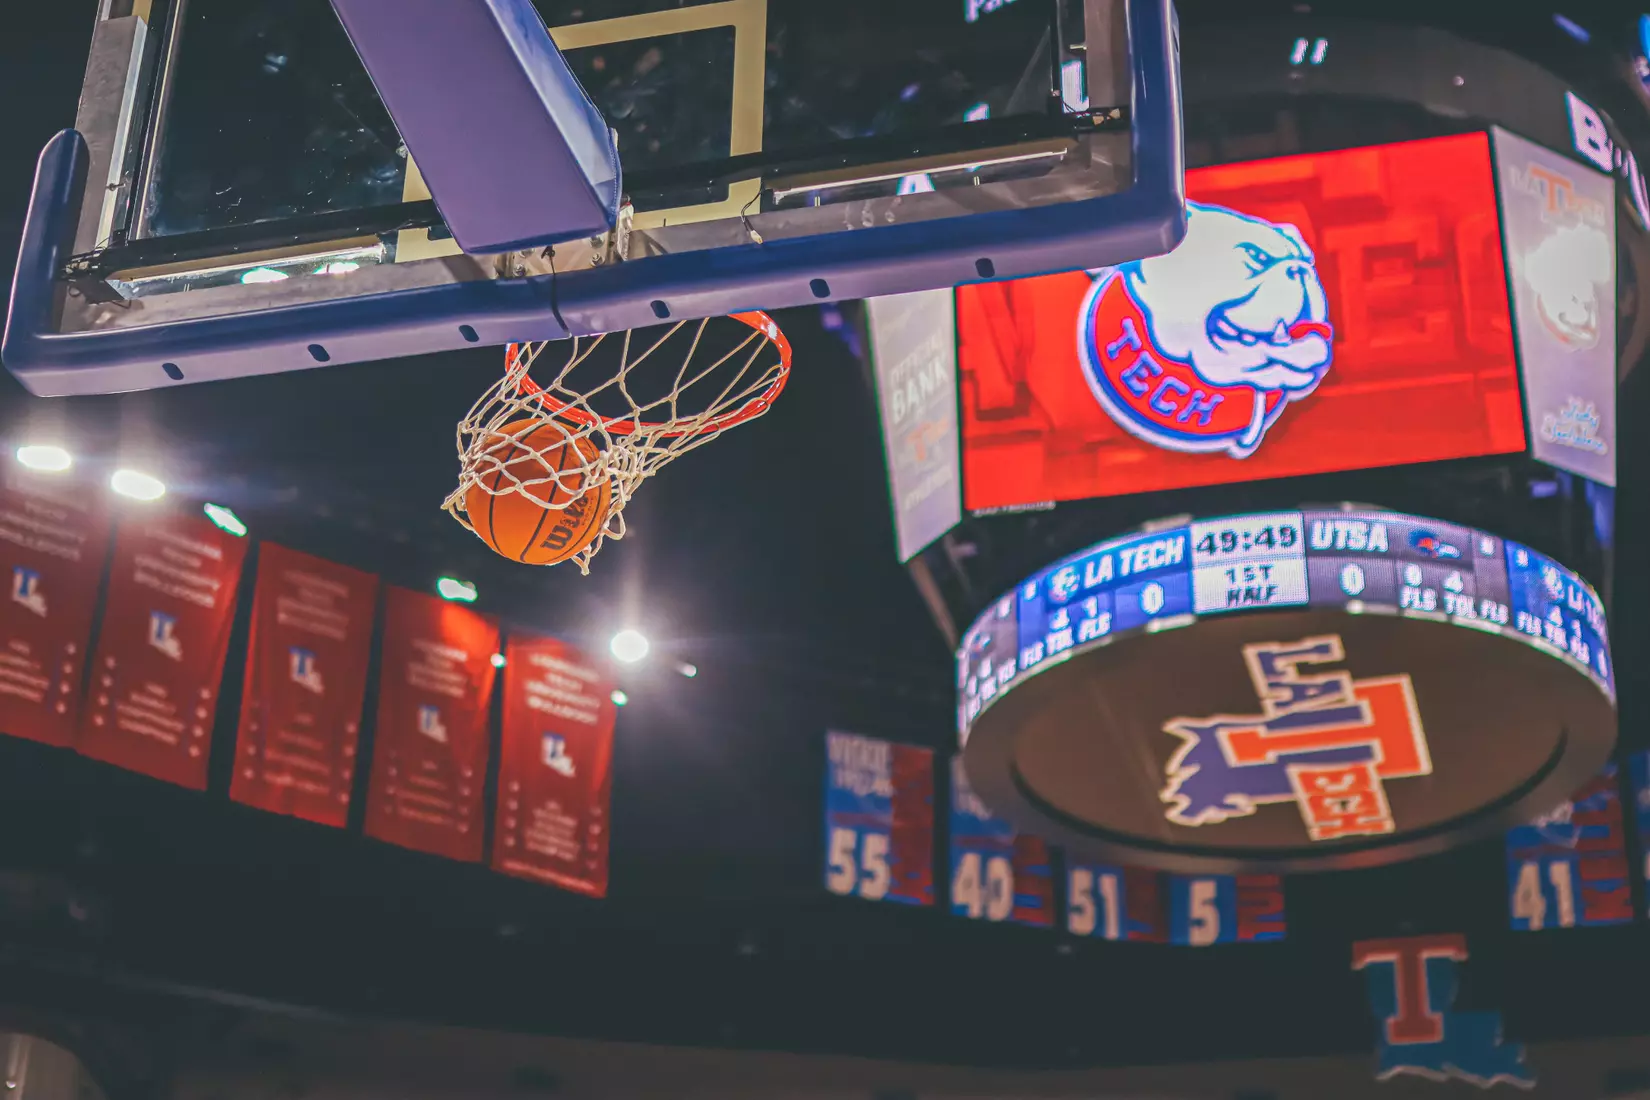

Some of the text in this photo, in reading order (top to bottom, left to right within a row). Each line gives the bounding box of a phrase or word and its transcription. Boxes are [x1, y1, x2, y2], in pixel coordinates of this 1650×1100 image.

[892, 352, 948, 425] BANK
[1106, 316, 1225, 426] TECH
[1196, 524, 1298, 556] 49:49
[1310, 519, 1389, 552] UTSA
[1084, 536, 1185, 589] LA TECH
[1225, 564, 1274, 584] 1ST
[1340, 563, 1366, 596] 0
[1083, 595, 1098, 618] 1
[1141, 580, 1164, 615] 0
[1226, 585, 1279, 607] HALF
[1400, 586, 1437, 611] FLS
[1078, 612, 1112, 642] FLS
[828, 828, 891, 900] 55
[952, 852, 1014, 922] 40
[1067, 868, 1120, 940] 51
[1513, 859, 1575, 931] 41
[1188, 879, 1221, 947] 5
[1351, 933, 1468, 1045] T
